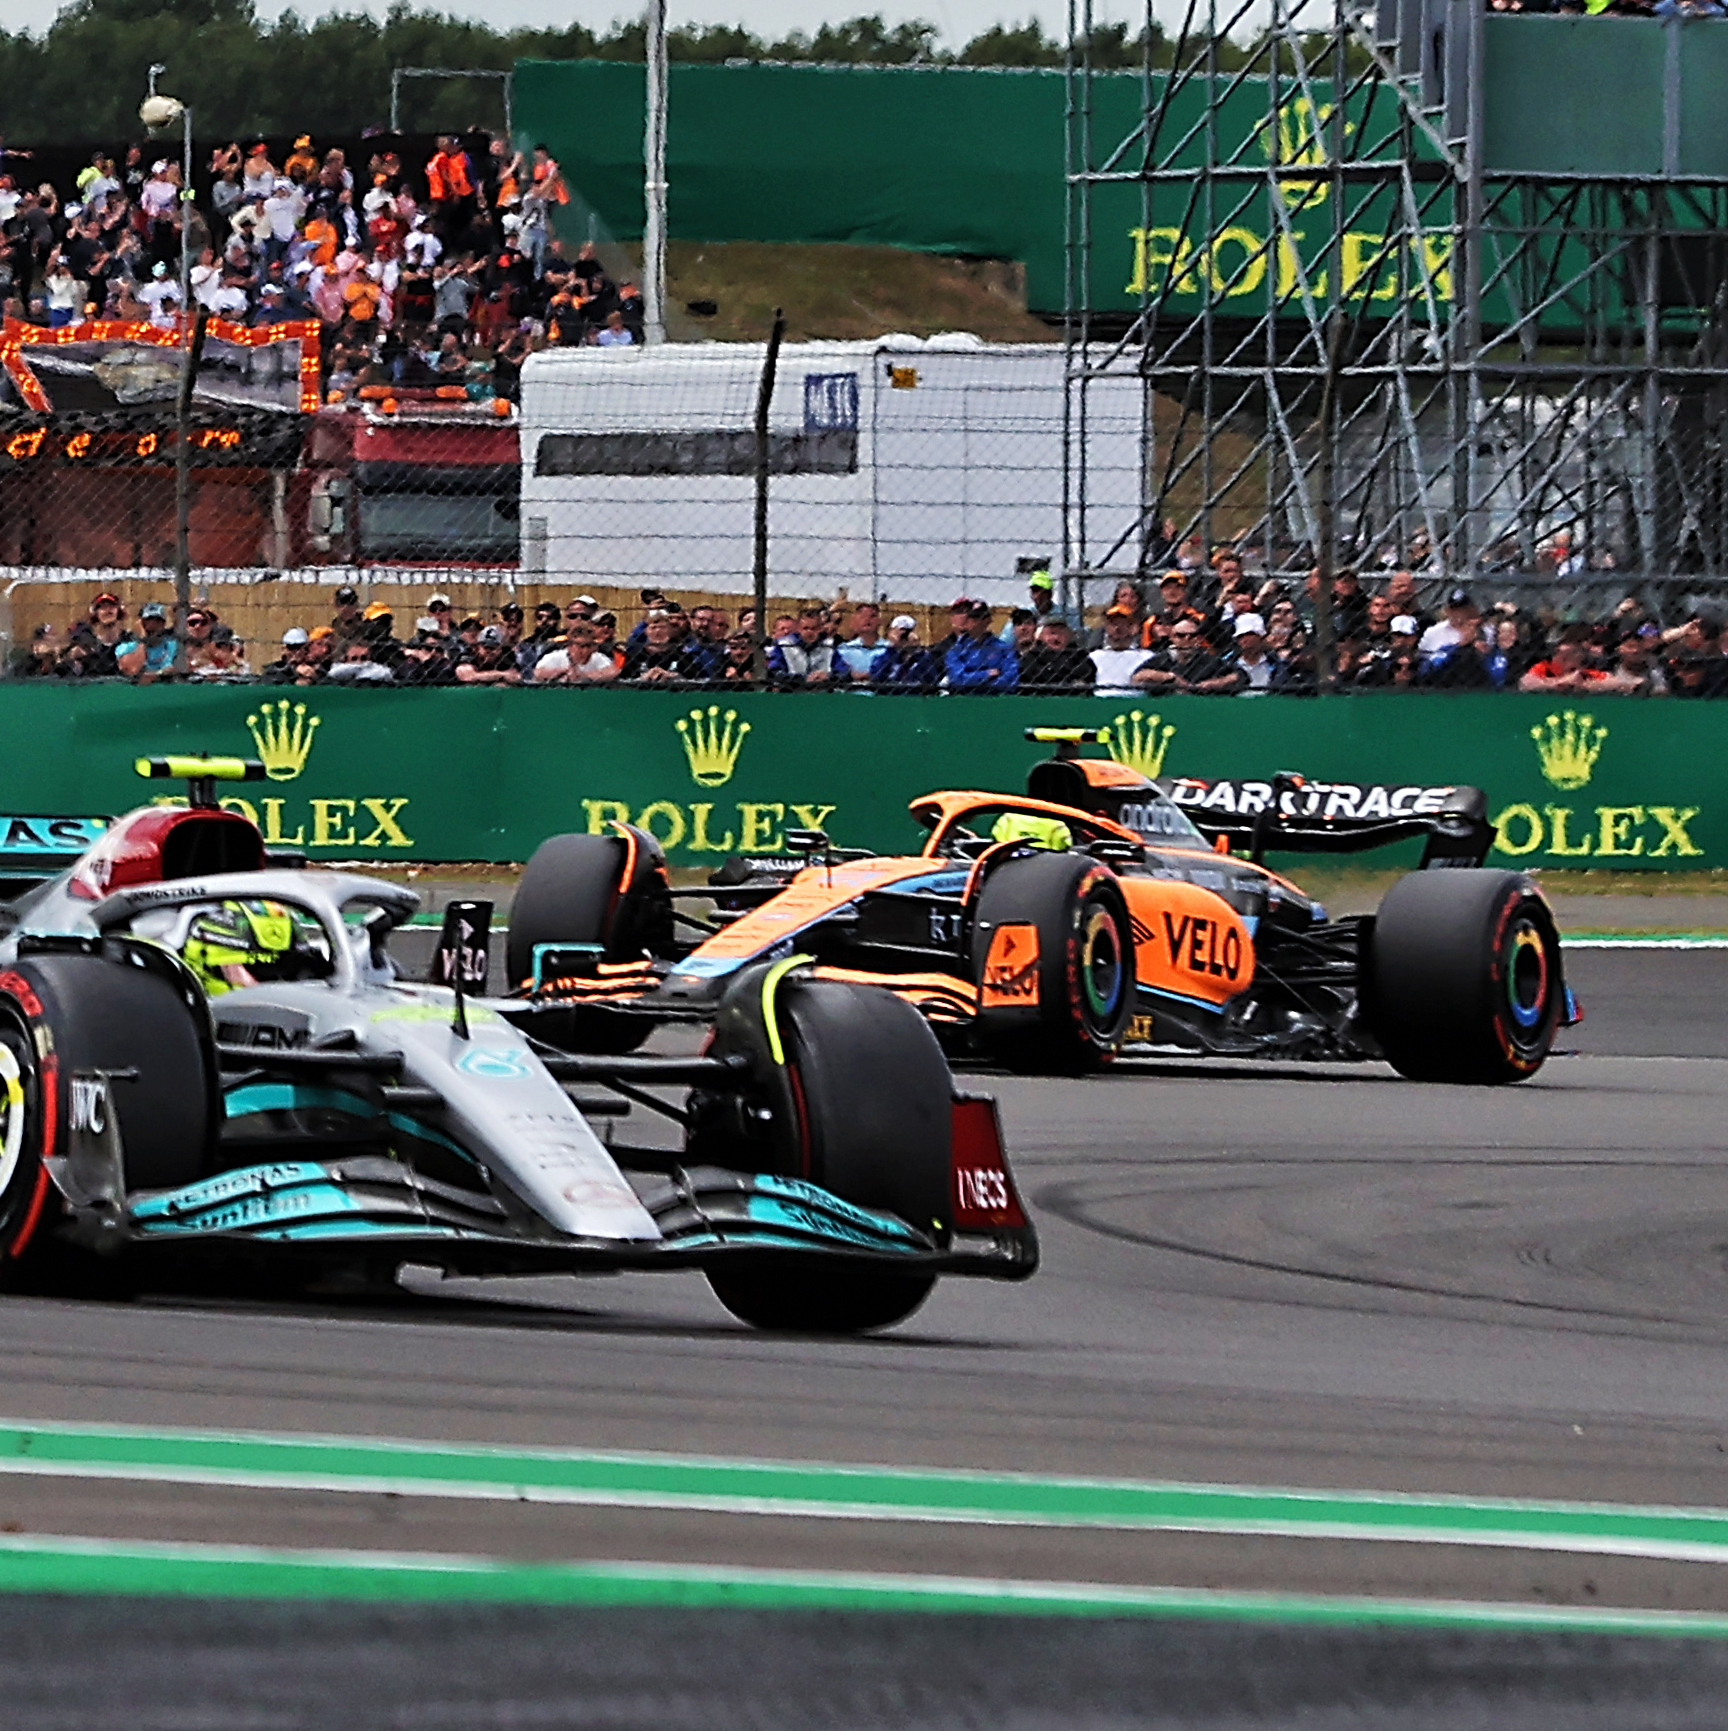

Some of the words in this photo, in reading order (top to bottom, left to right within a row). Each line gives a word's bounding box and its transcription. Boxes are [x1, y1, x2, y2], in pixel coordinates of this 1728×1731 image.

[1124, 225, 1455, 301] ROLEX
[1489, 803, 1705, 857] OLEX
[1163, 912, 1242, 981] VELO
